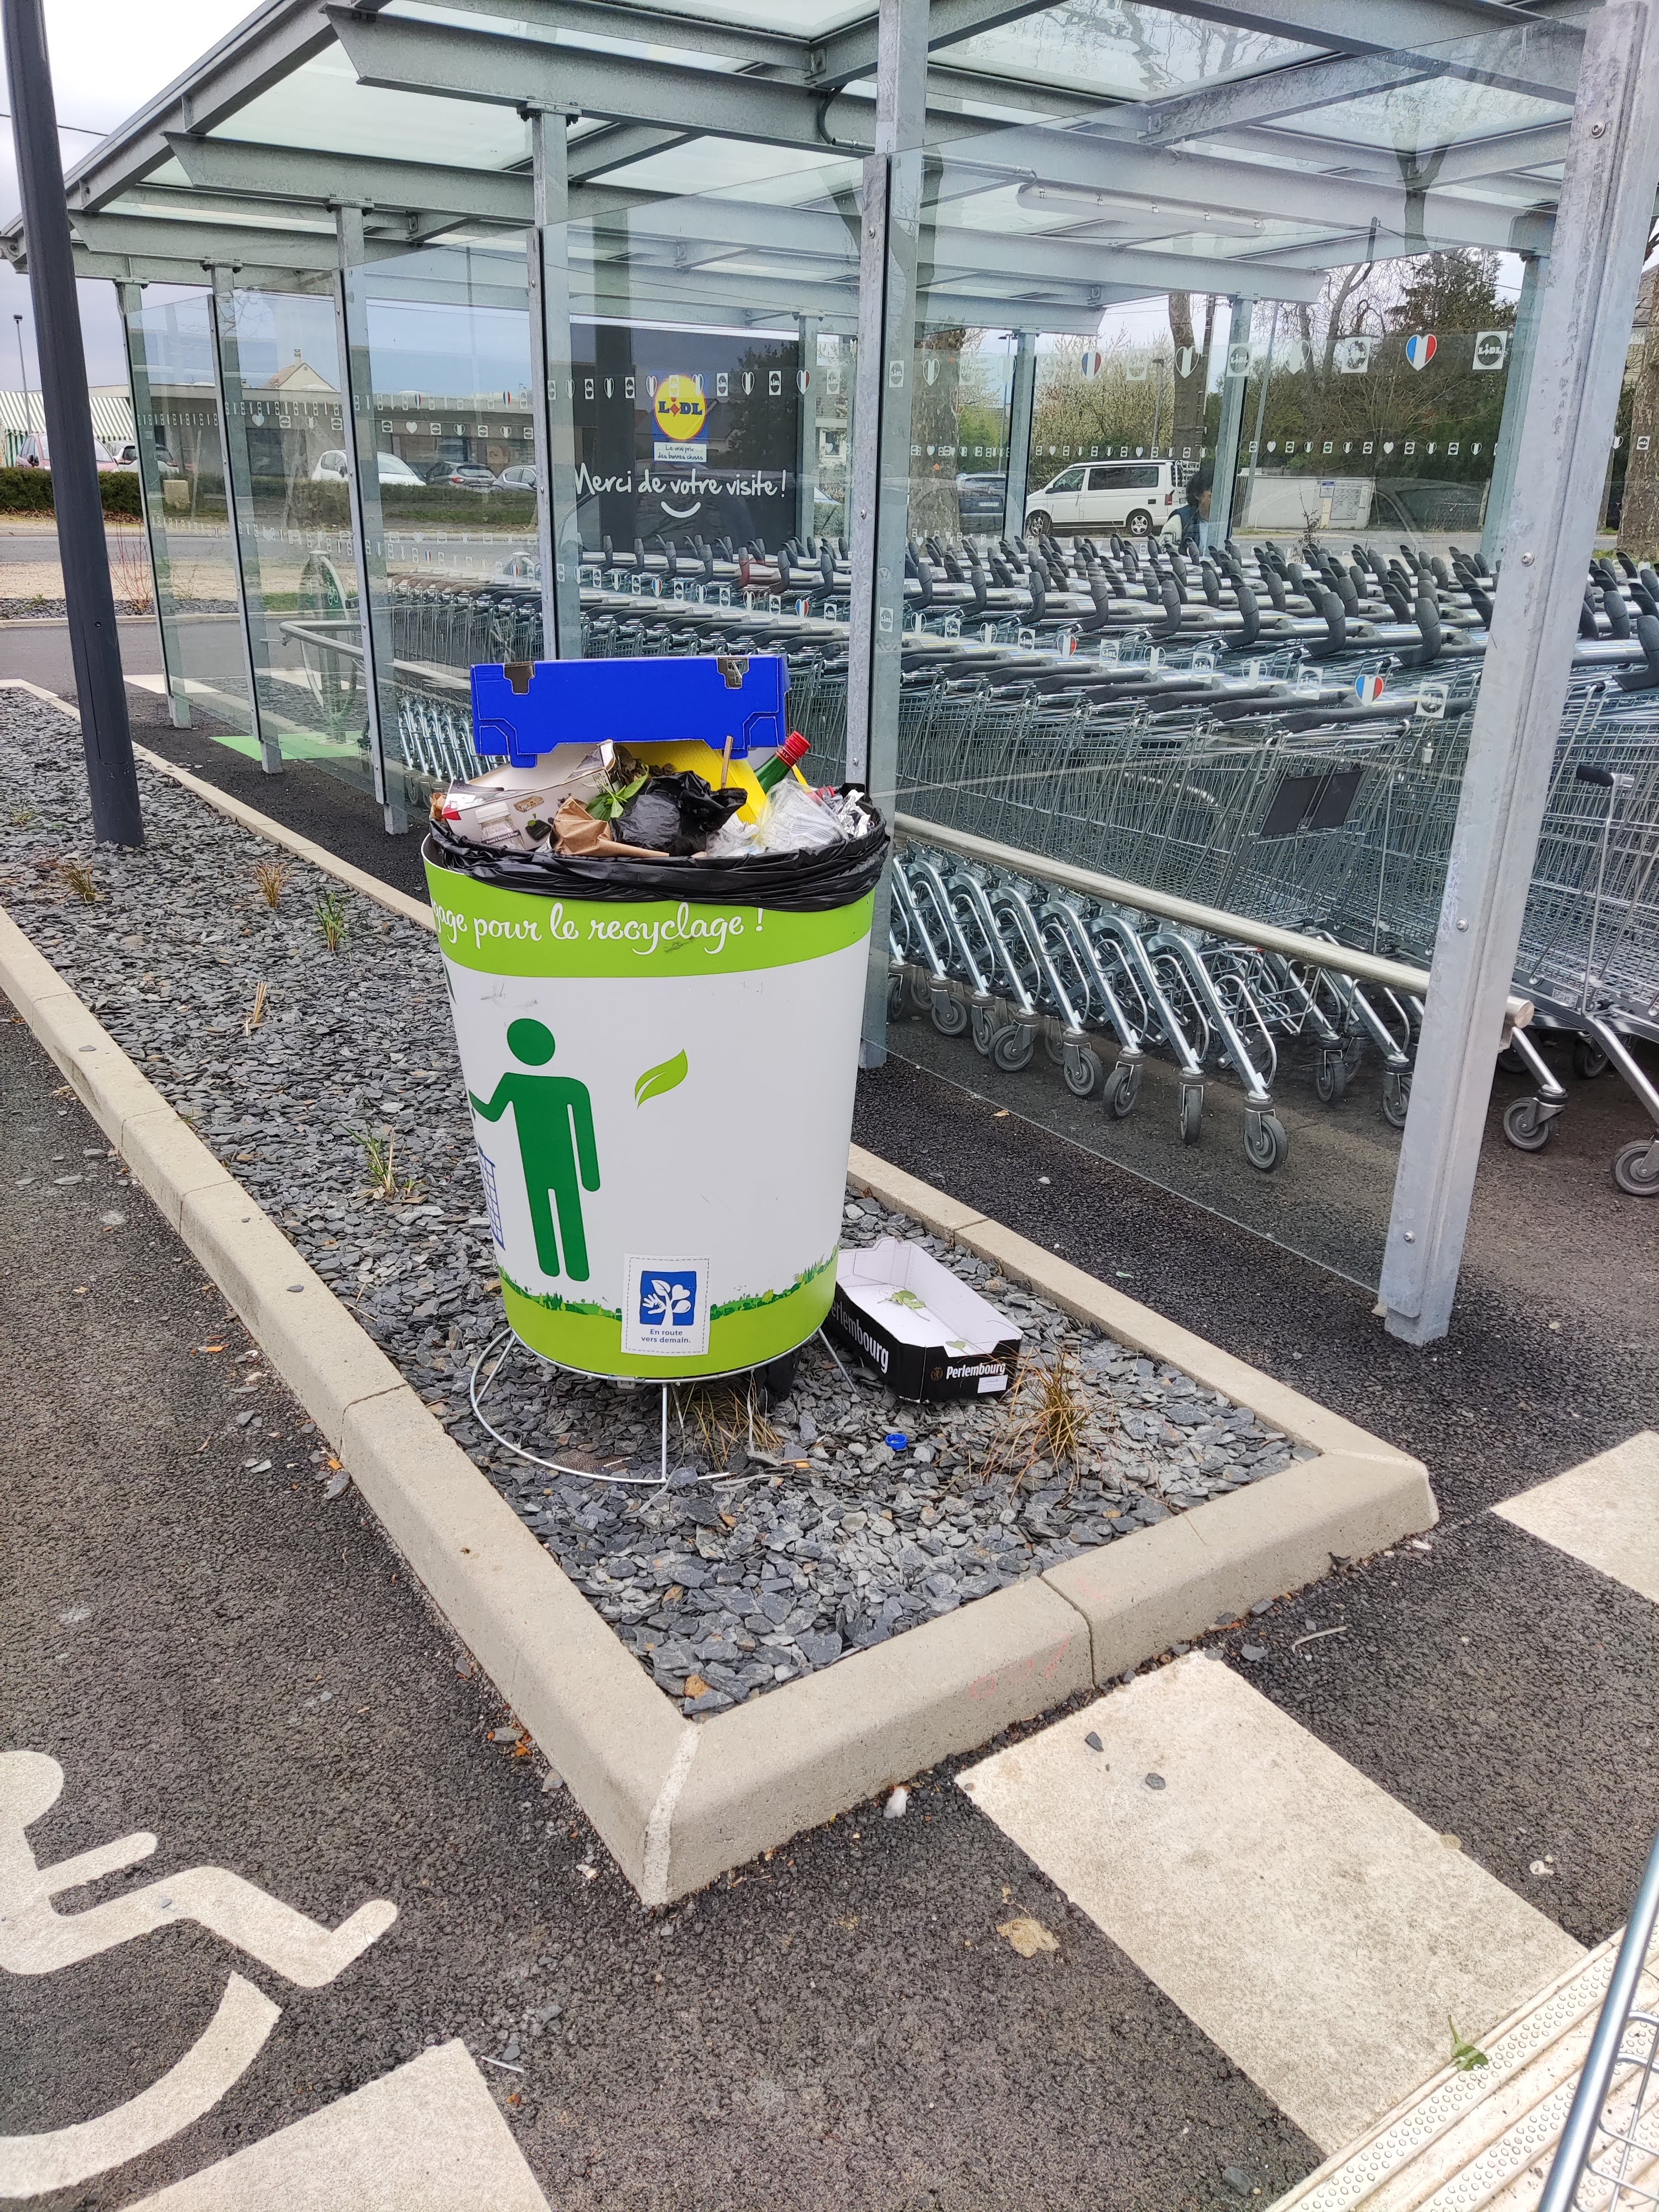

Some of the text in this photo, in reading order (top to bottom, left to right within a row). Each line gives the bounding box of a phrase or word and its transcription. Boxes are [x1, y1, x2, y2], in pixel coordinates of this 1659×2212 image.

[575, 462, 632, 495] Merci
[638, 468, 666, 494] de
[670, 468, 723, 495] votre
[777, 747, 790, 759] TALY
[430, 896, 468, 944] gage
[473, 917, 542, 950] pour
[549, 902, 580, 941] le
[587, 902, 744, 955] recyclage
[831, 1300, 889, 1374] erlembourg
[946, 1362, 1006, 1380] Perlembourg
